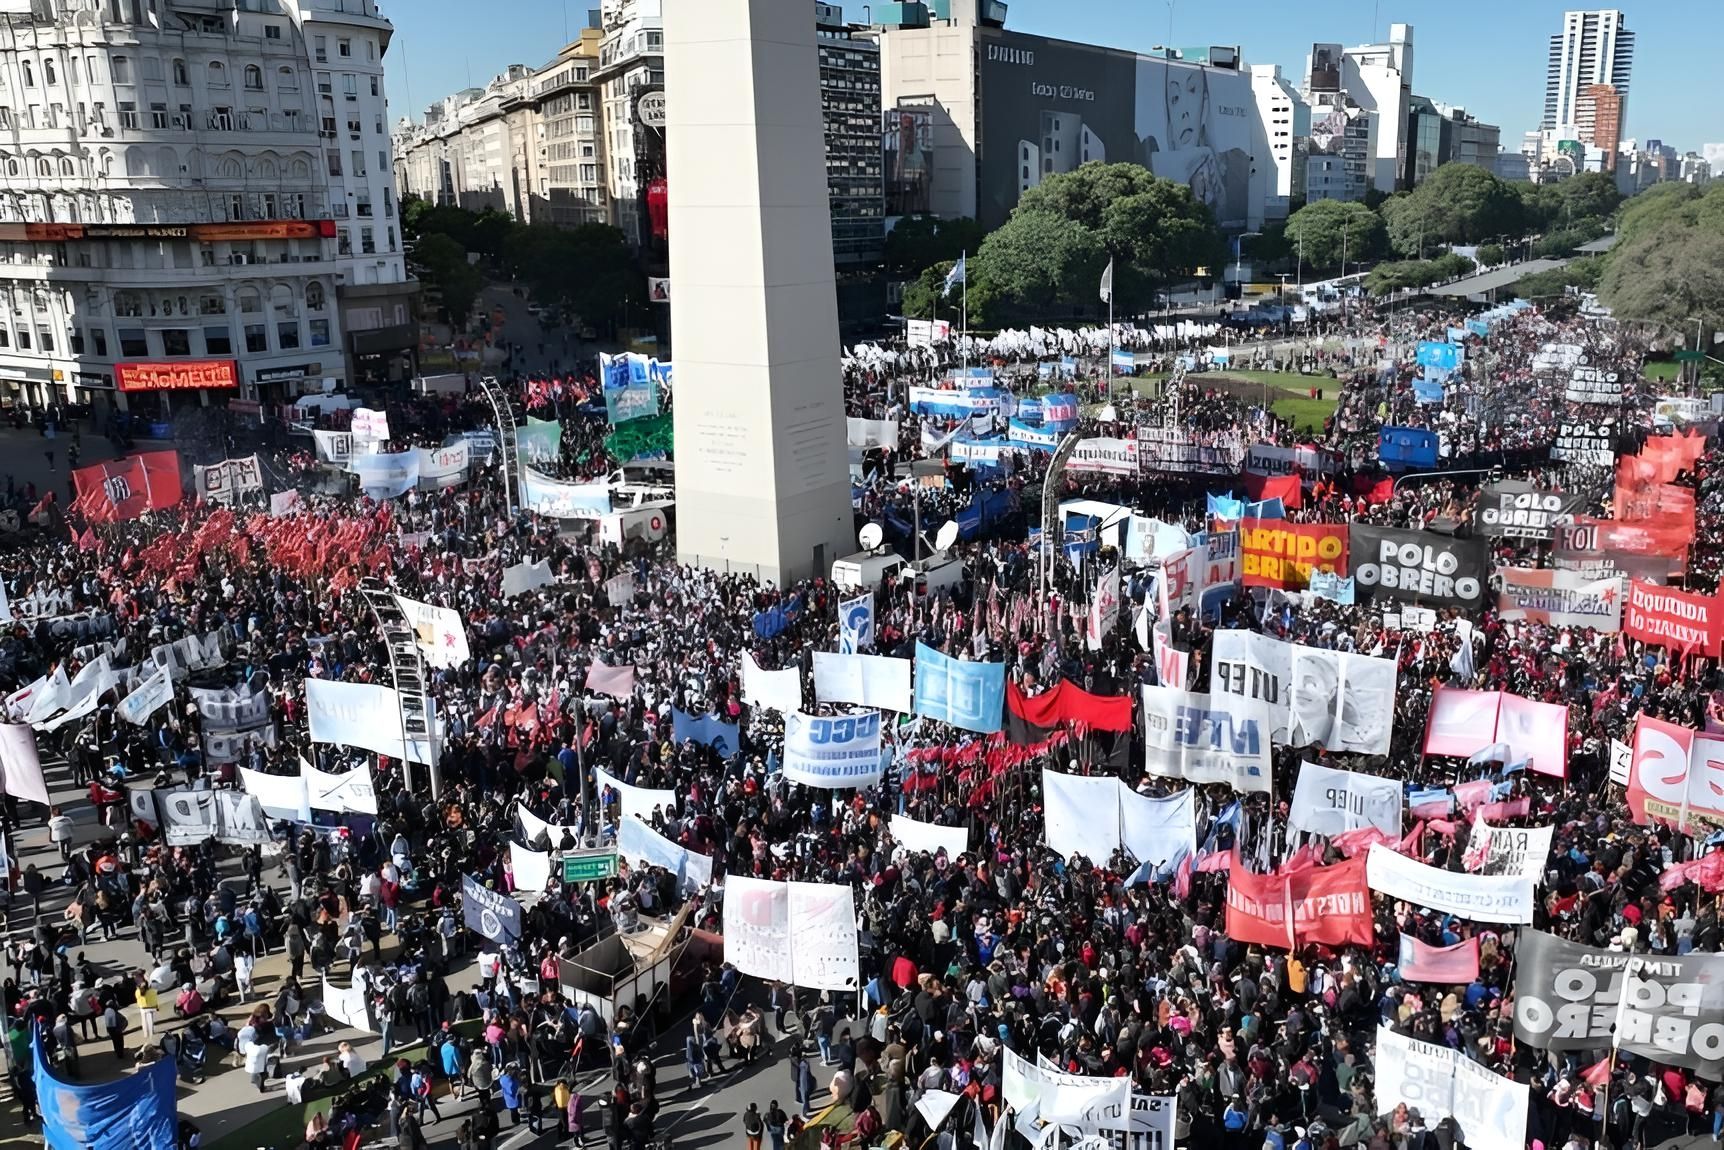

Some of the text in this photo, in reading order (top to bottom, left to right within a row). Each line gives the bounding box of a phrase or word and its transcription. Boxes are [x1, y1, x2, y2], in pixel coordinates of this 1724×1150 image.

[1560, 423, 1610, 437] POLO
[1500, 493, 1561, 511] POLO
[1380, 540, 1458, 575] POLO
[1357, 563, 1480, 600] OBRERO
